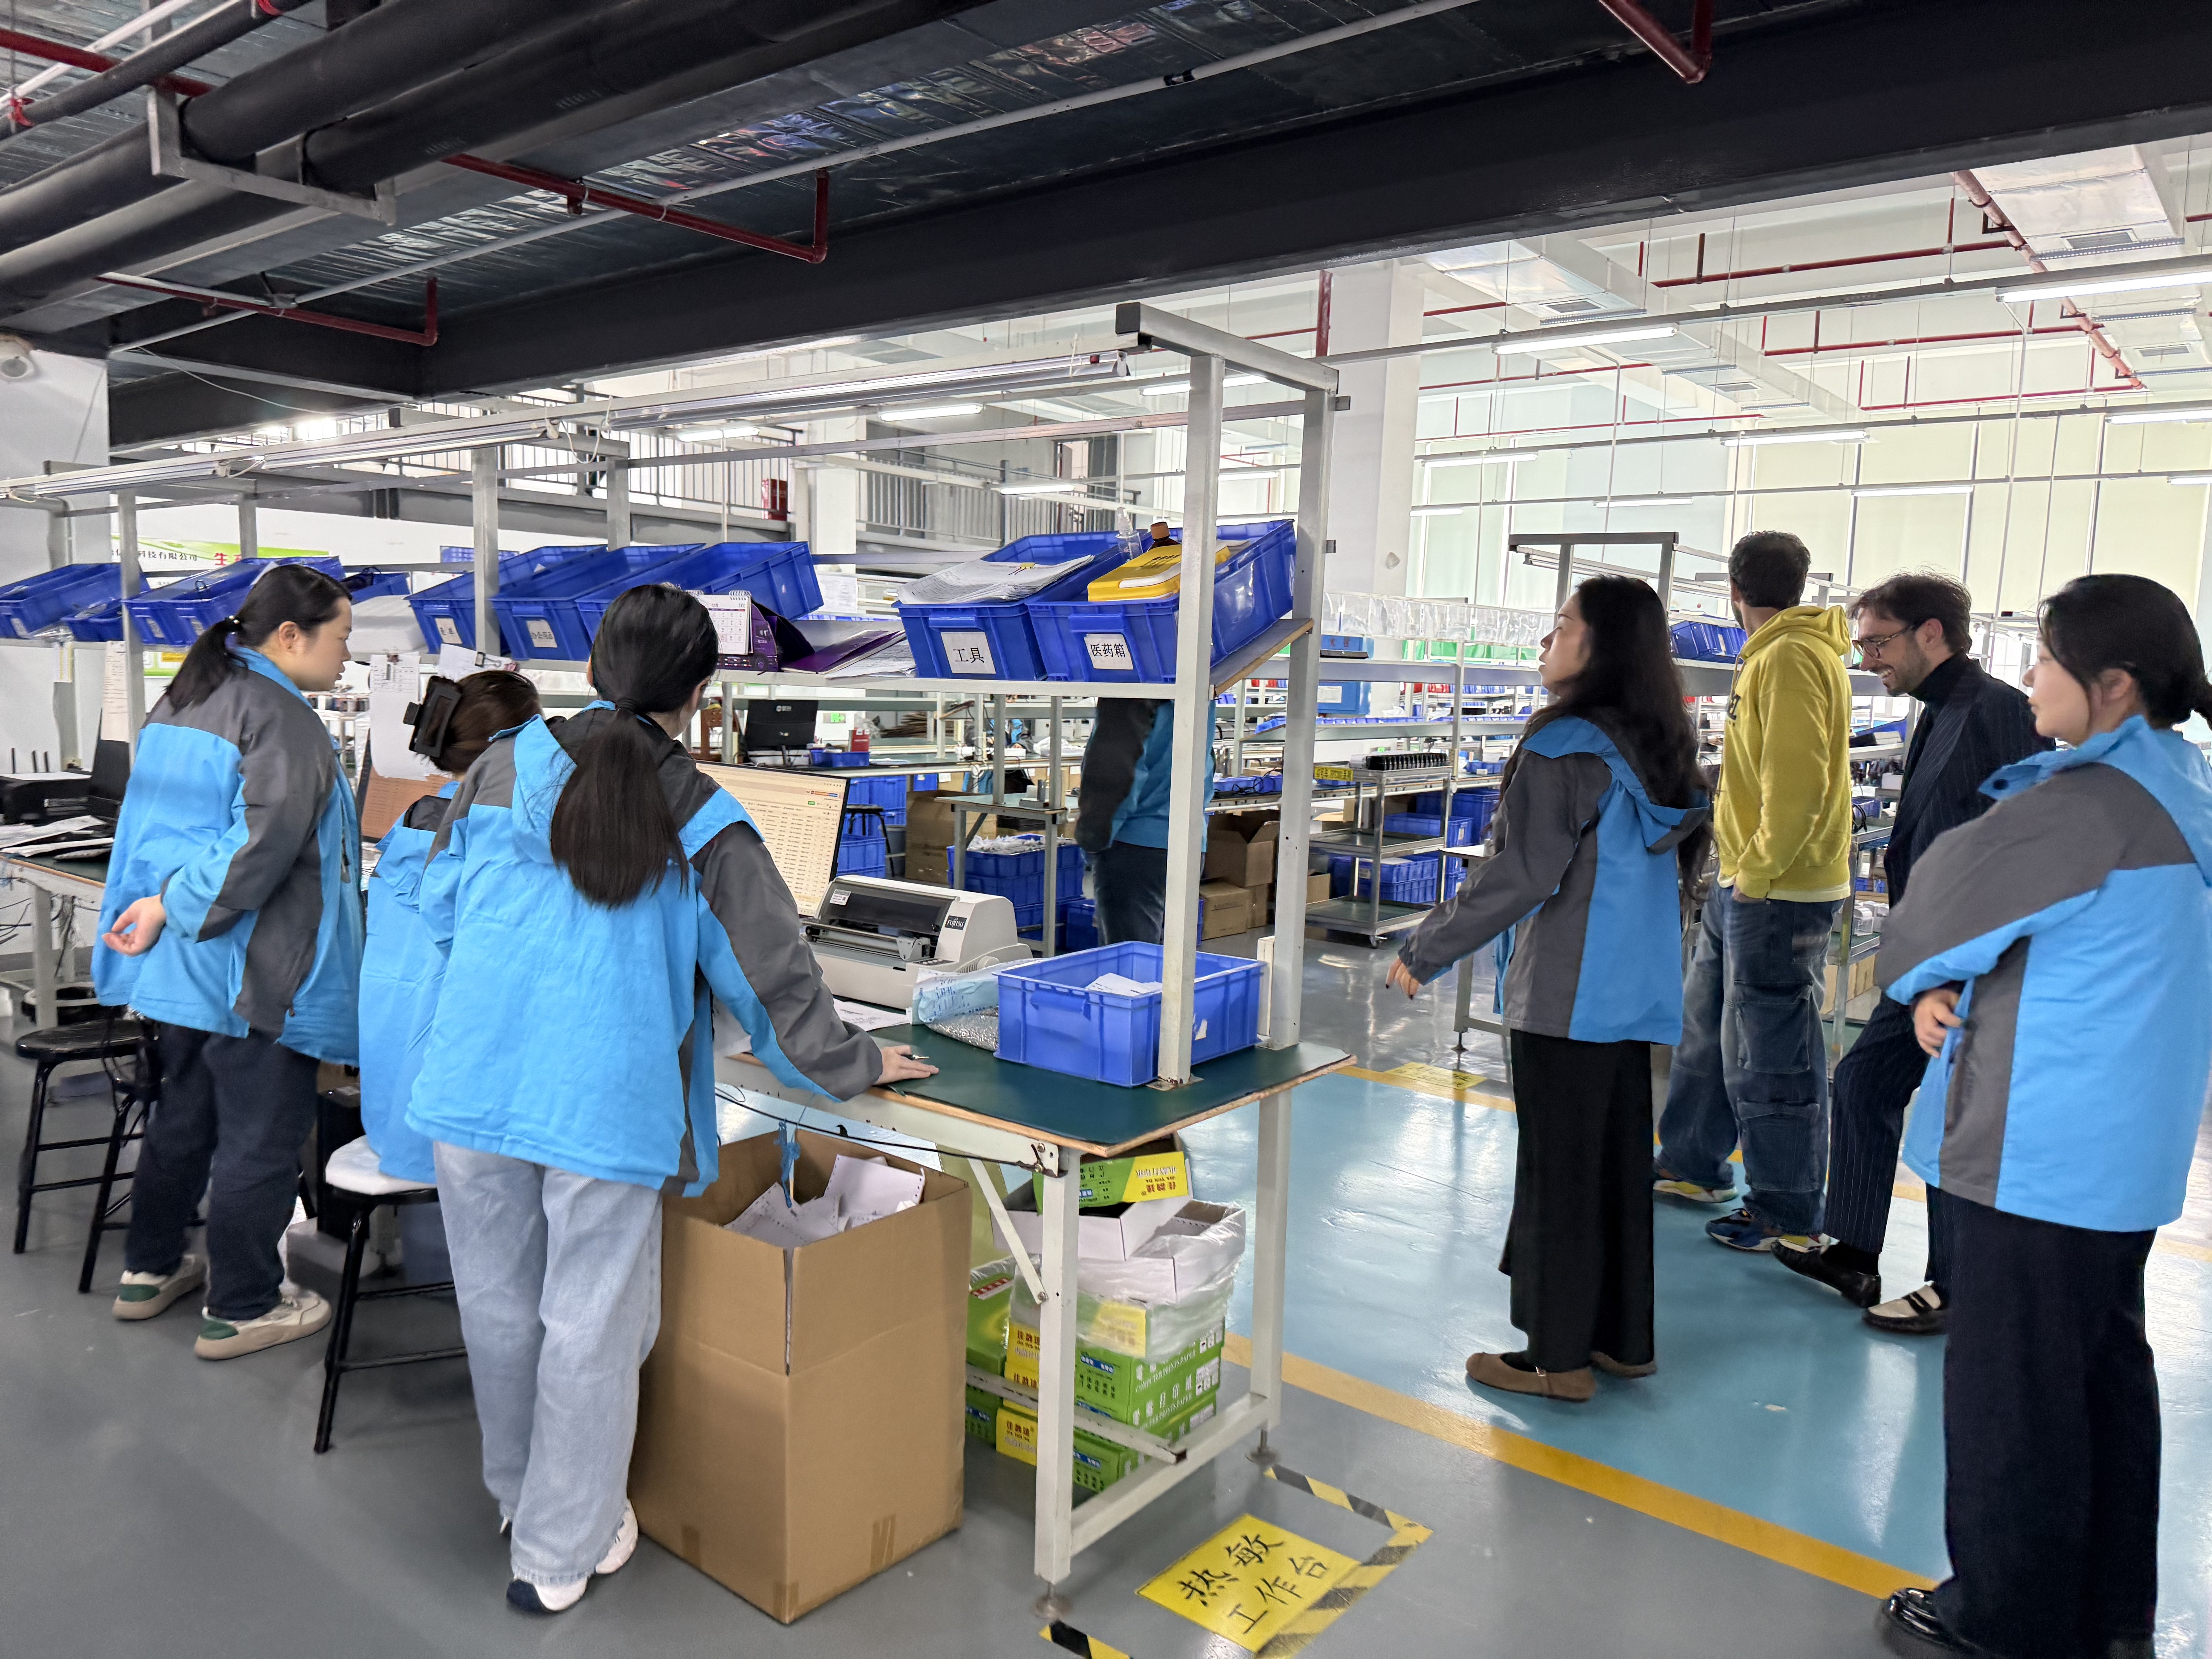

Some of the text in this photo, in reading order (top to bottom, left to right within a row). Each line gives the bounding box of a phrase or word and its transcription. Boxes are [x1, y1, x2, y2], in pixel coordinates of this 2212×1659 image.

[953, 647, 984, 663] 工具
[1091, 643, 1125, 658] 医药箱
[947, 917, 964, 927] FUJITSU
[1178, 1534, 1285, 1607] 热敏
[1228, 1556, 1328, 1634] 工作台
